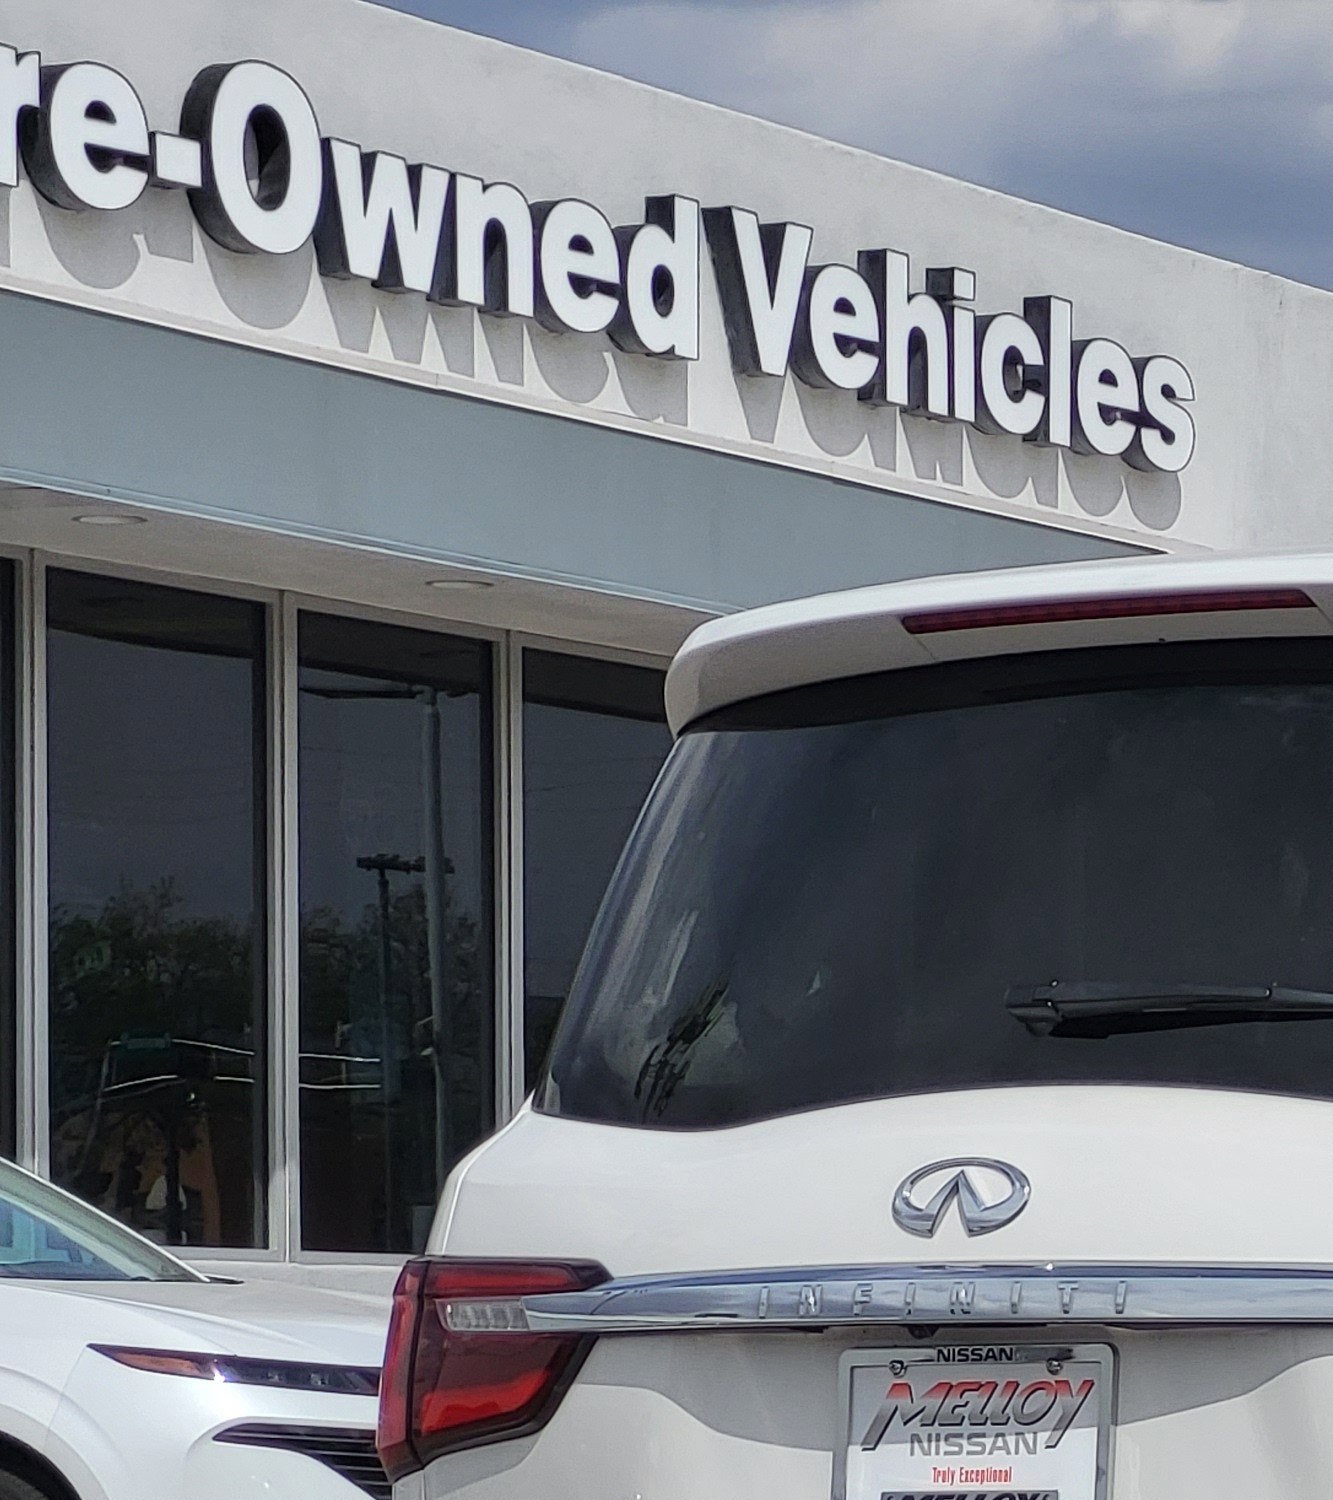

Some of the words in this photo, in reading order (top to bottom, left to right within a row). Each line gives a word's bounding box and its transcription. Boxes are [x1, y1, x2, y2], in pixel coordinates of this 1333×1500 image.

[702, 206, 1195, 472] Vehicles
[757, 1280, 1128, 1319] INFINITI
[936, 1347, 1014, 1362] NISSAN
[861, 1379, 1096, 1451] MELLOY
[909, 1431, 1038, 1456] NISSAN
[932, 1466, 956, 1486] Truly
[959, 1466, 1013, 1483] Exceptional
